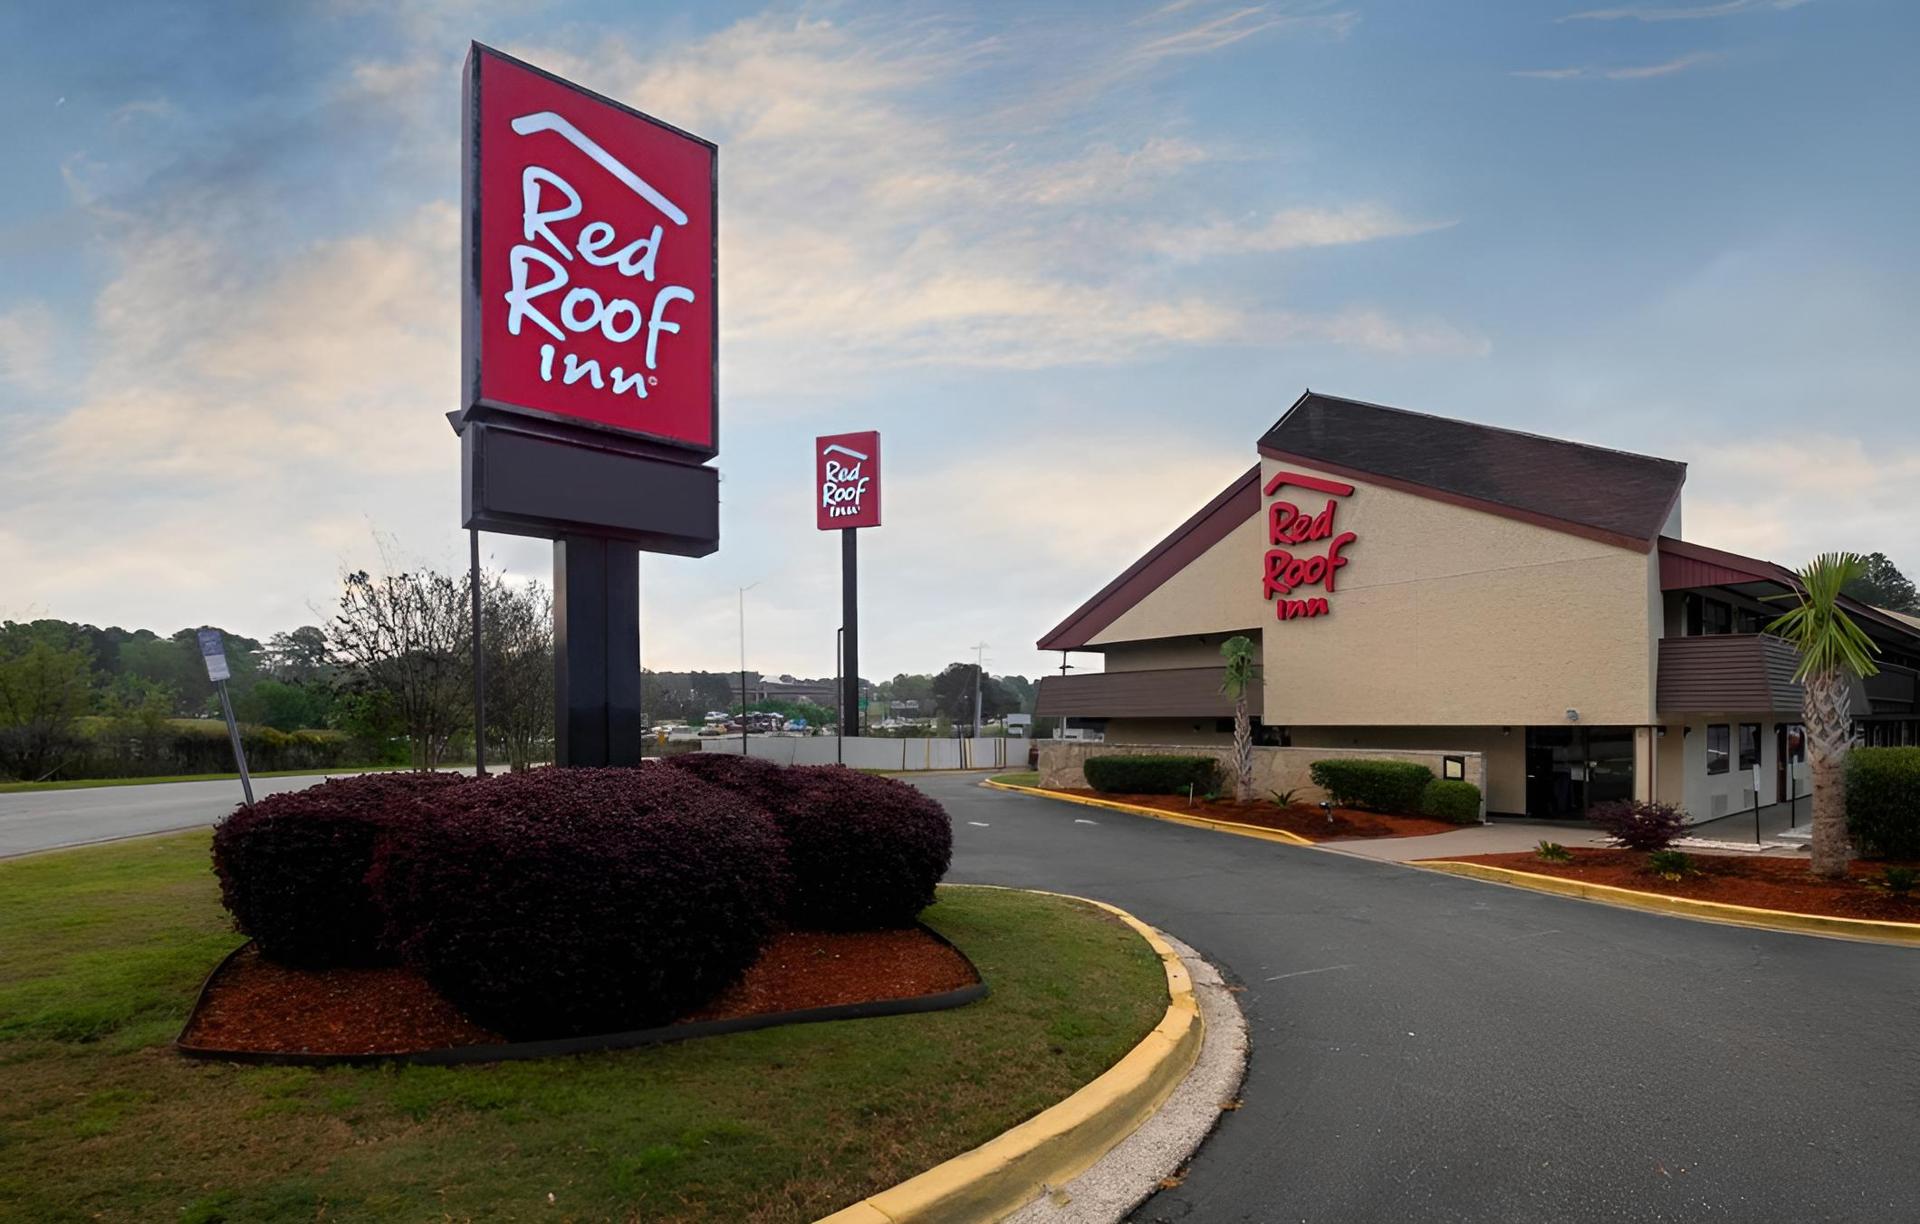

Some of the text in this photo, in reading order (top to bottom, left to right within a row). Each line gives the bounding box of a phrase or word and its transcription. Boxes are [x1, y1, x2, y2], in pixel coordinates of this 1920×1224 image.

[522, 165, 664, 282] Red
[504, 244, 695, 370] Roof
[822, 476, 870, 508] Roof
[825, 460, 861, 483] Red
[1268, 499, 1337, 546] Red
[1262, 531, 1358, 600] Roof
